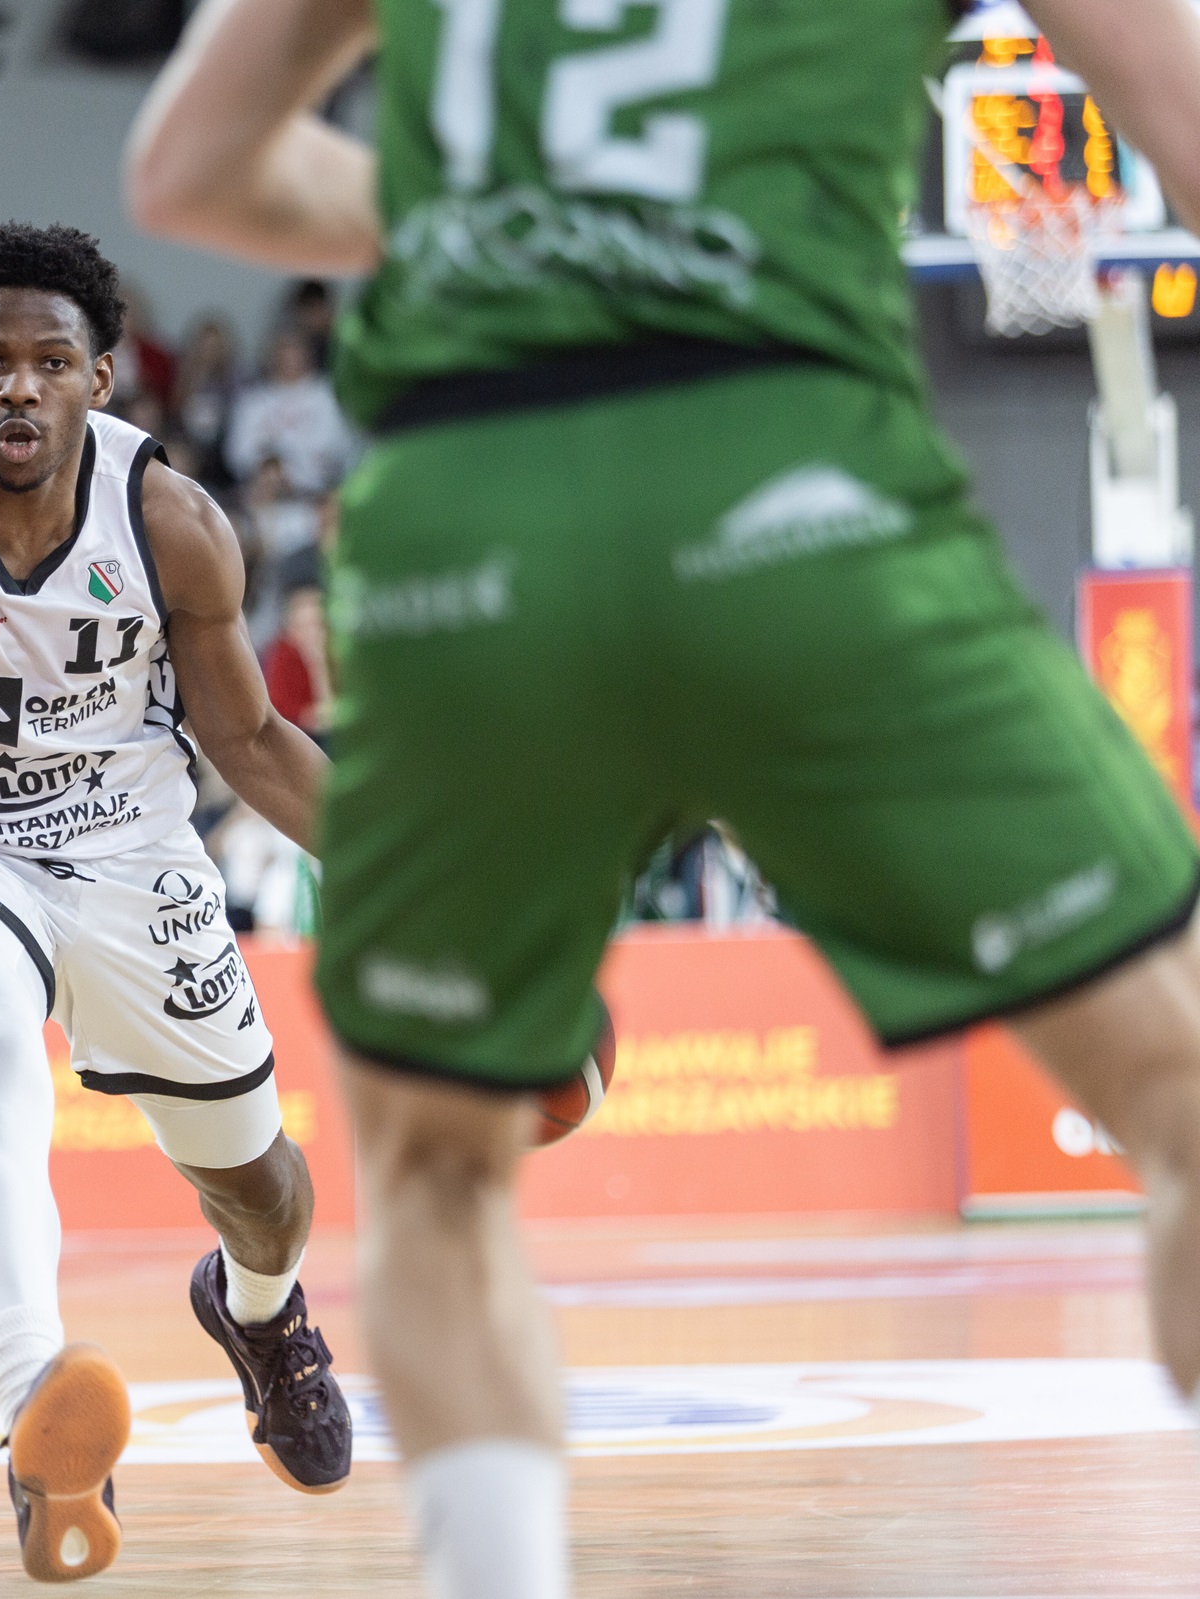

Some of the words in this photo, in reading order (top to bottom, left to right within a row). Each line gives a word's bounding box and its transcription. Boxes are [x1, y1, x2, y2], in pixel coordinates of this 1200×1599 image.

[64, 615, 144, 674] 11
[25, 677, 116, 715] ORLEN
[28, 694, 117, 737] TERMIKA
[184, 957, 237, 1010] LOTTO
[238, 997, 256, 1031] 4F
